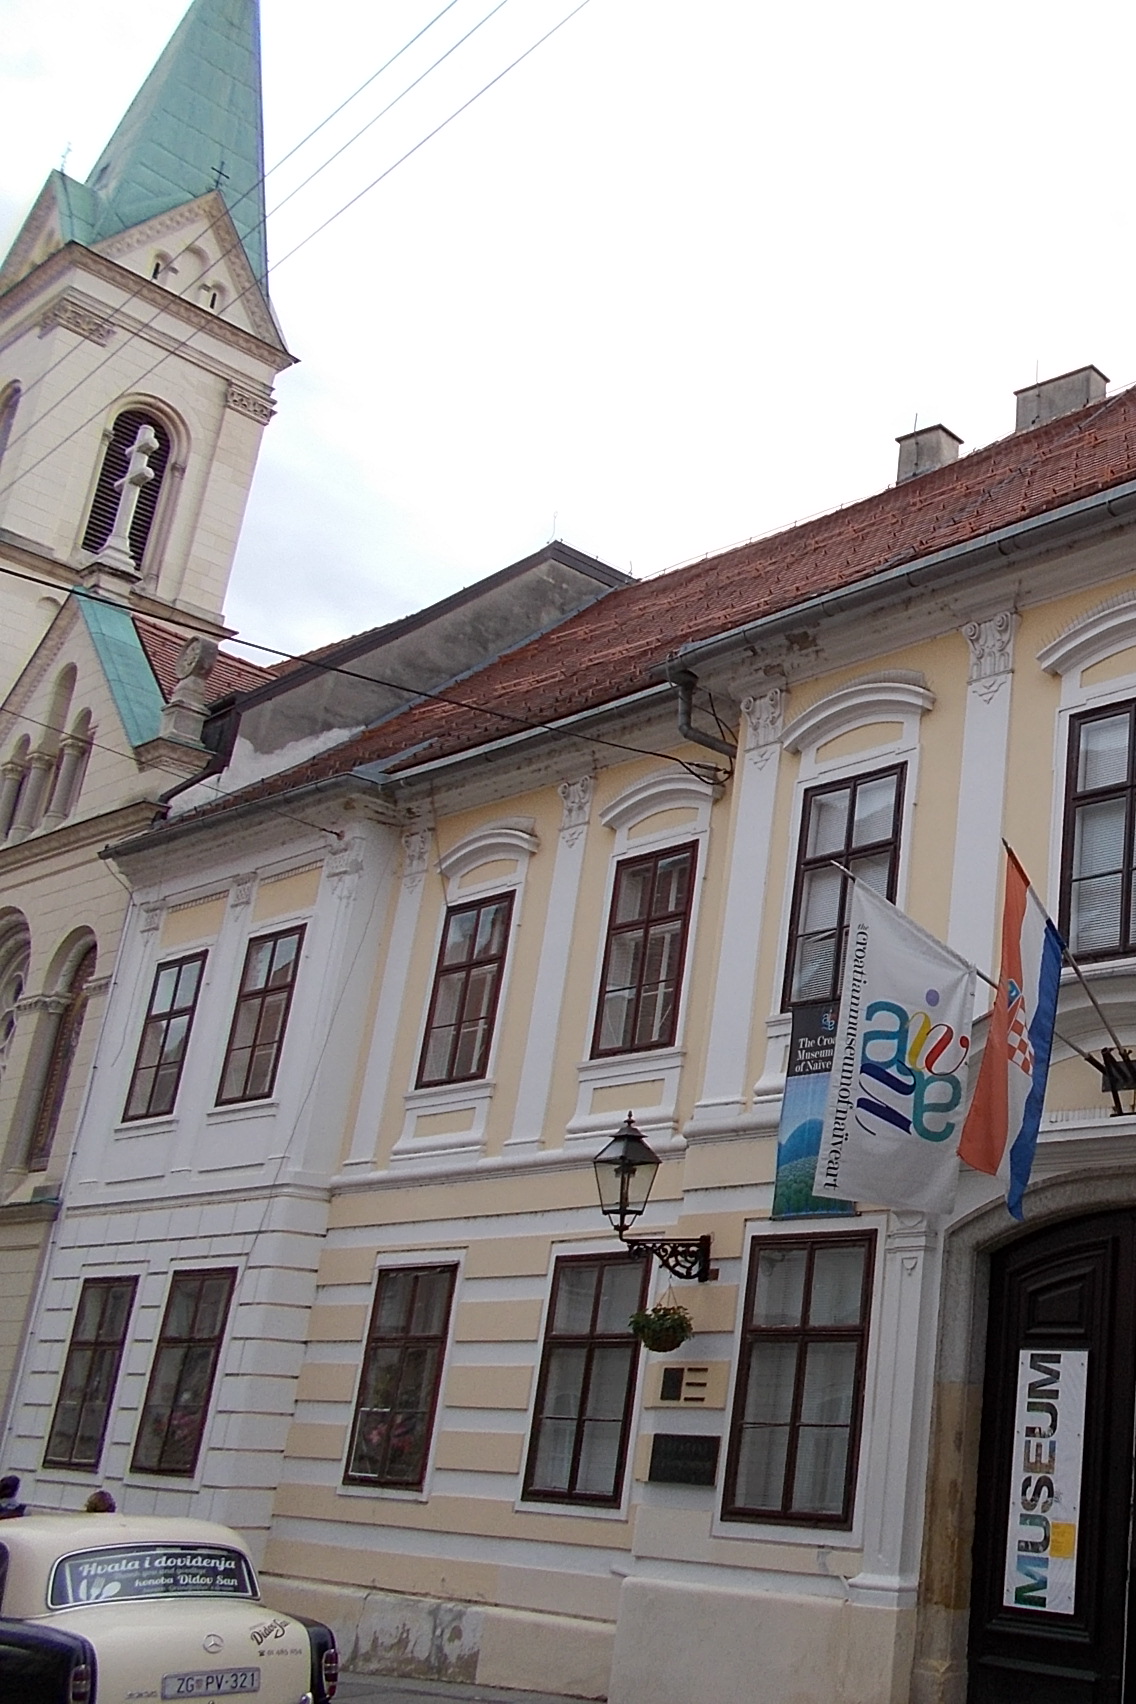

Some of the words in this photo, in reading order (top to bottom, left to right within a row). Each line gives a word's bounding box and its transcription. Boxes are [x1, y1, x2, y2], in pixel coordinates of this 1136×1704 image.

[798, 1037, 816, 1049] The
[797, 1049, 834, 1061] Museum
[795, 1061, 806, 1072] of
[1014, 1353, 1062, 1608] MUSEUM
[79, 1558, 140, 1576] Hvala
[144, 1555, 151, 1568] i
[134, 1576, 174, 1588] konoba
[177, 1574, 214, 1585] Didov
[216, 1574, 239, 1586] San
[176, 1676, 195, 1694] ZG
